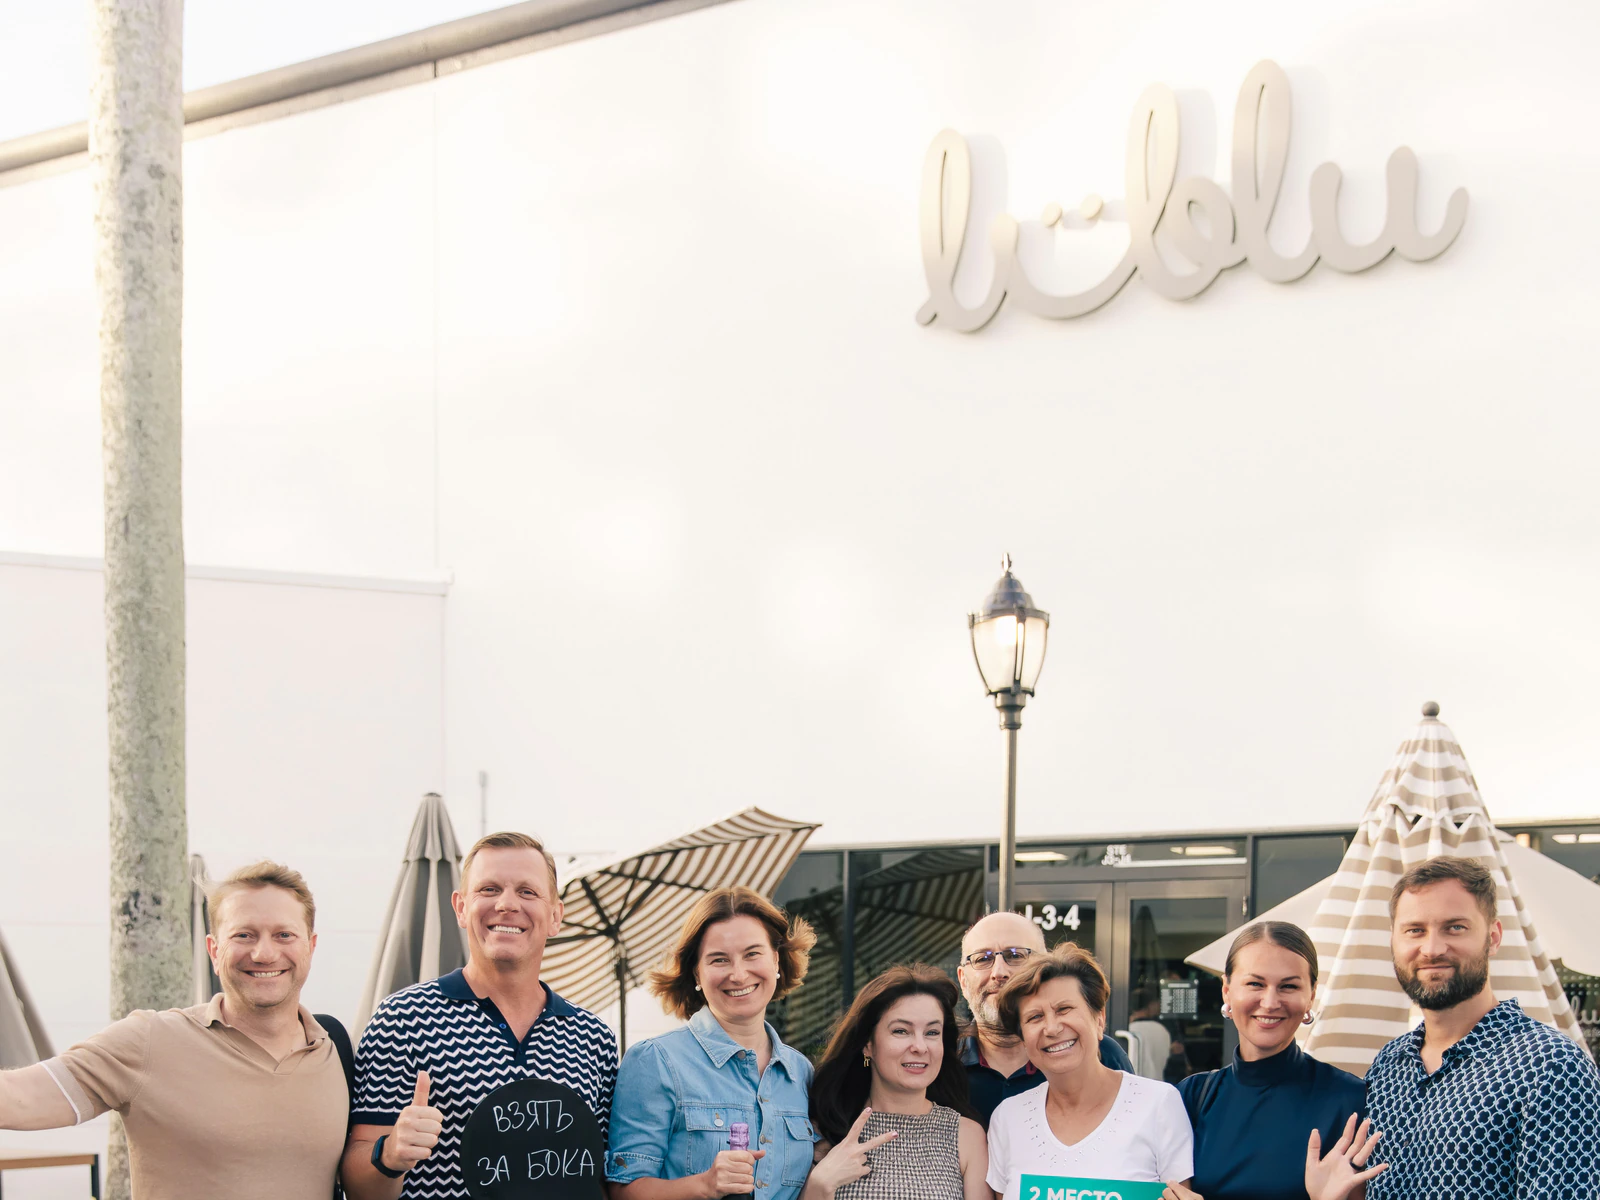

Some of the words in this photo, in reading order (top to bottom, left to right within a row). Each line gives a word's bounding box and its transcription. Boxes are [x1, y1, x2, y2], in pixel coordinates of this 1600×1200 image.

[493, 1099, 574, 1133] ВЗЯТЬ
[477, 1155, 511, 1186] ЗА
[527, 1148, 595, 1180] БОКА
